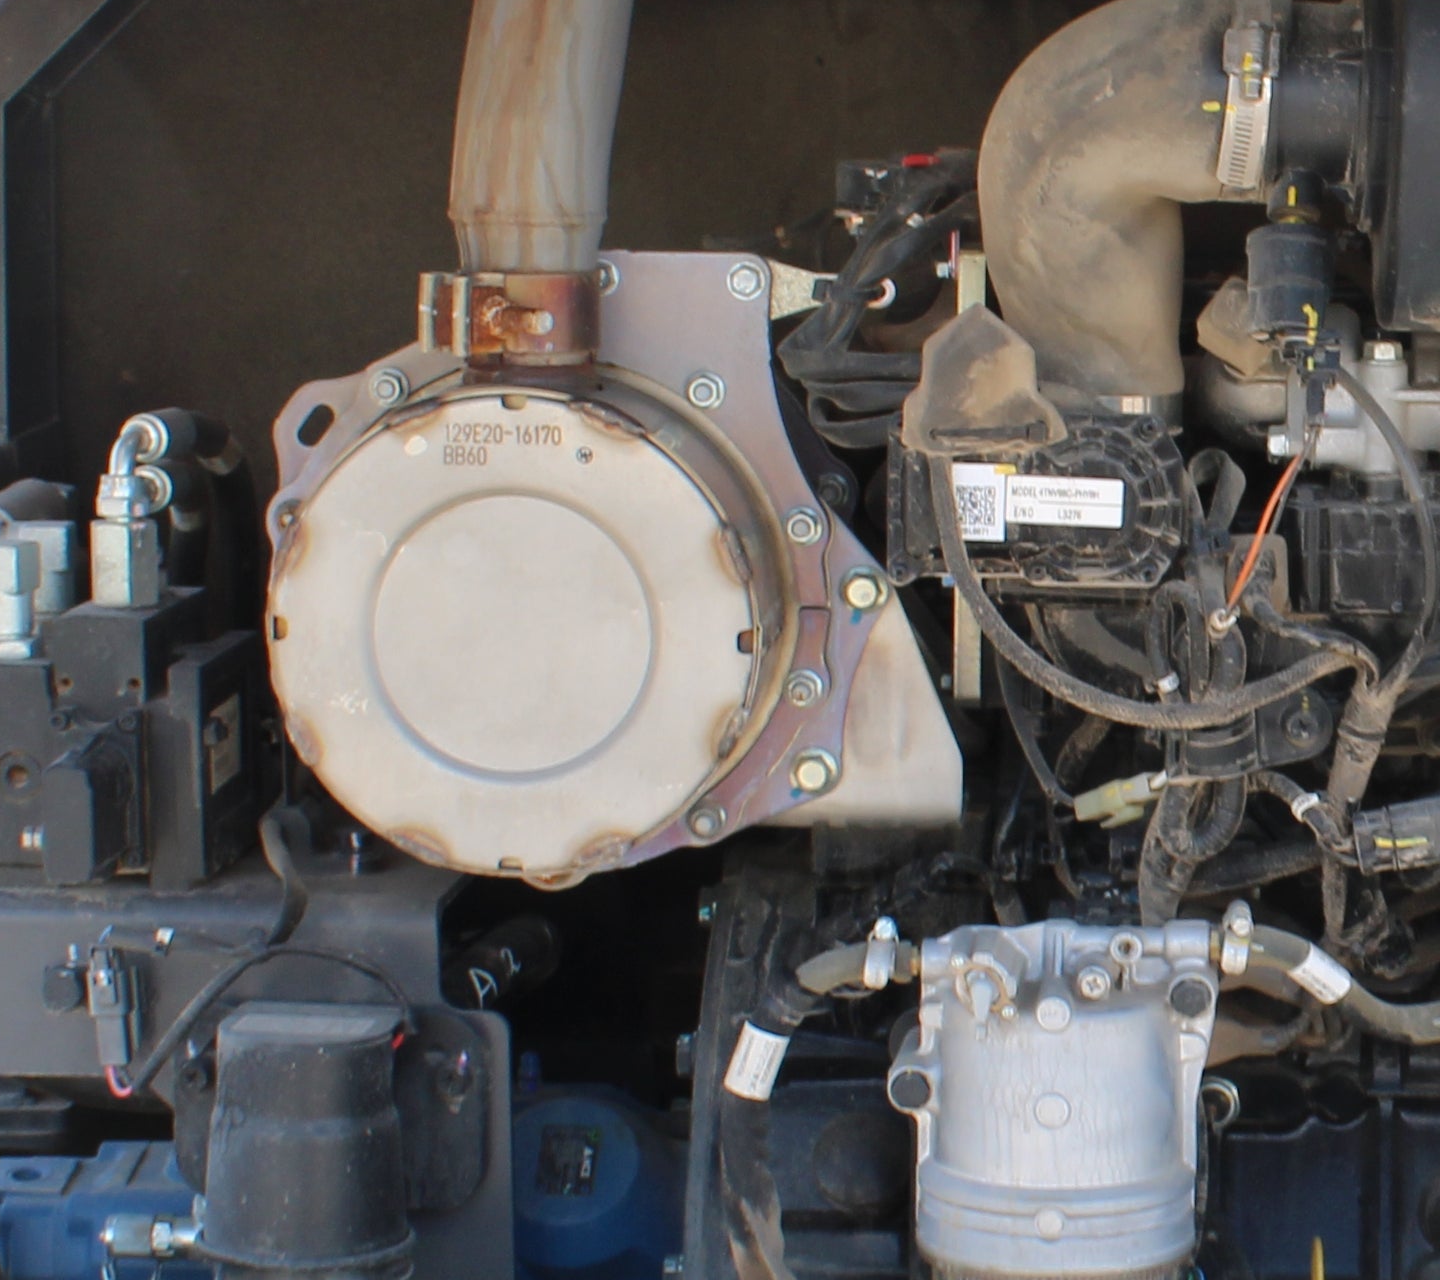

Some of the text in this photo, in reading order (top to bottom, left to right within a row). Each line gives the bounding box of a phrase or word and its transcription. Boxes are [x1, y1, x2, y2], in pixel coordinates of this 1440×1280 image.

[446, 423, 562, 446] 129E20-16170
[443, 446, 487, 465] BB60
[1011, 486, 1038, 498] MODEL
